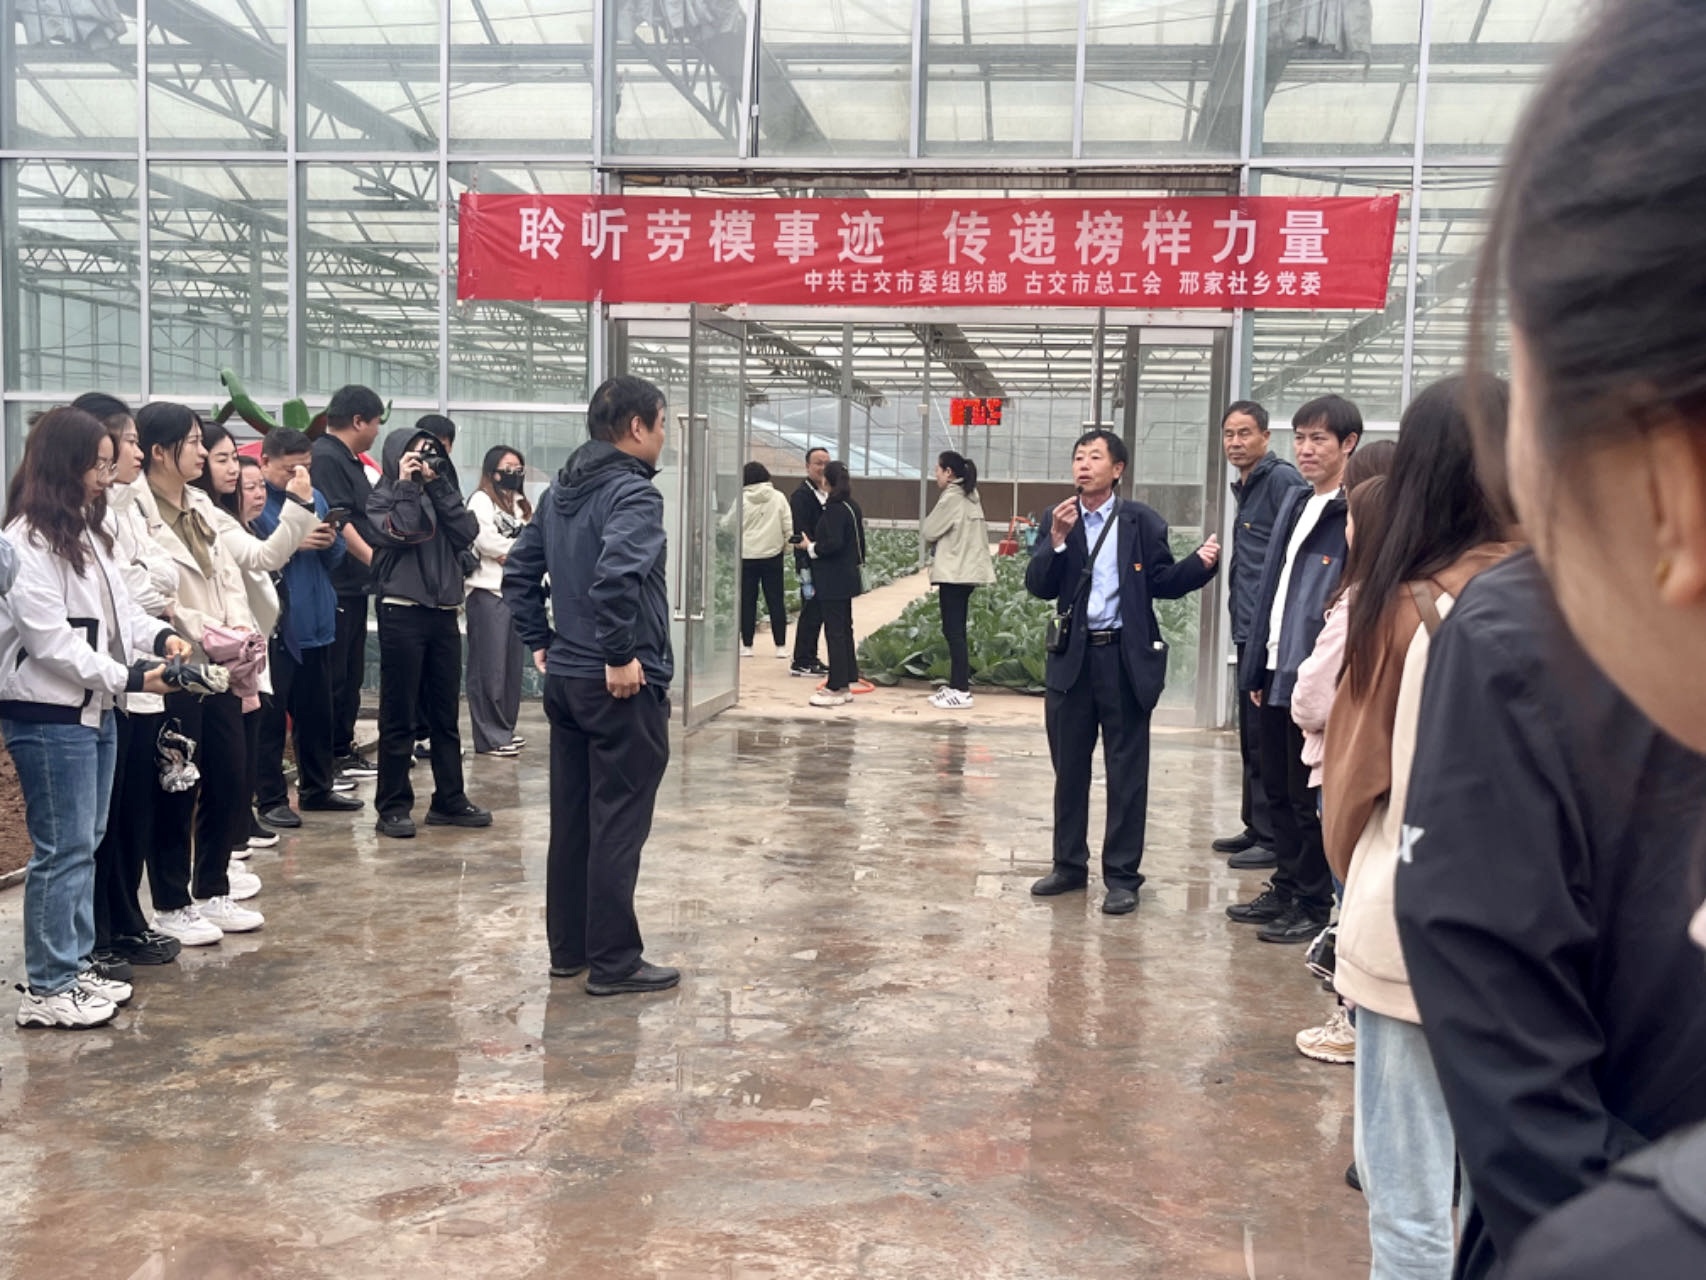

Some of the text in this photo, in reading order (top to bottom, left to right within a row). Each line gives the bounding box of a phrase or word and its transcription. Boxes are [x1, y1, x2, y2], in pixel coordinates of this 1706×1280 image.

[520, 207, 1329, 265] 聆听劳模事迹 传递榜样力量
[805, 269, 1320, 295] 中共古交市委组织部 古交市总工会 邢家社乡党委
